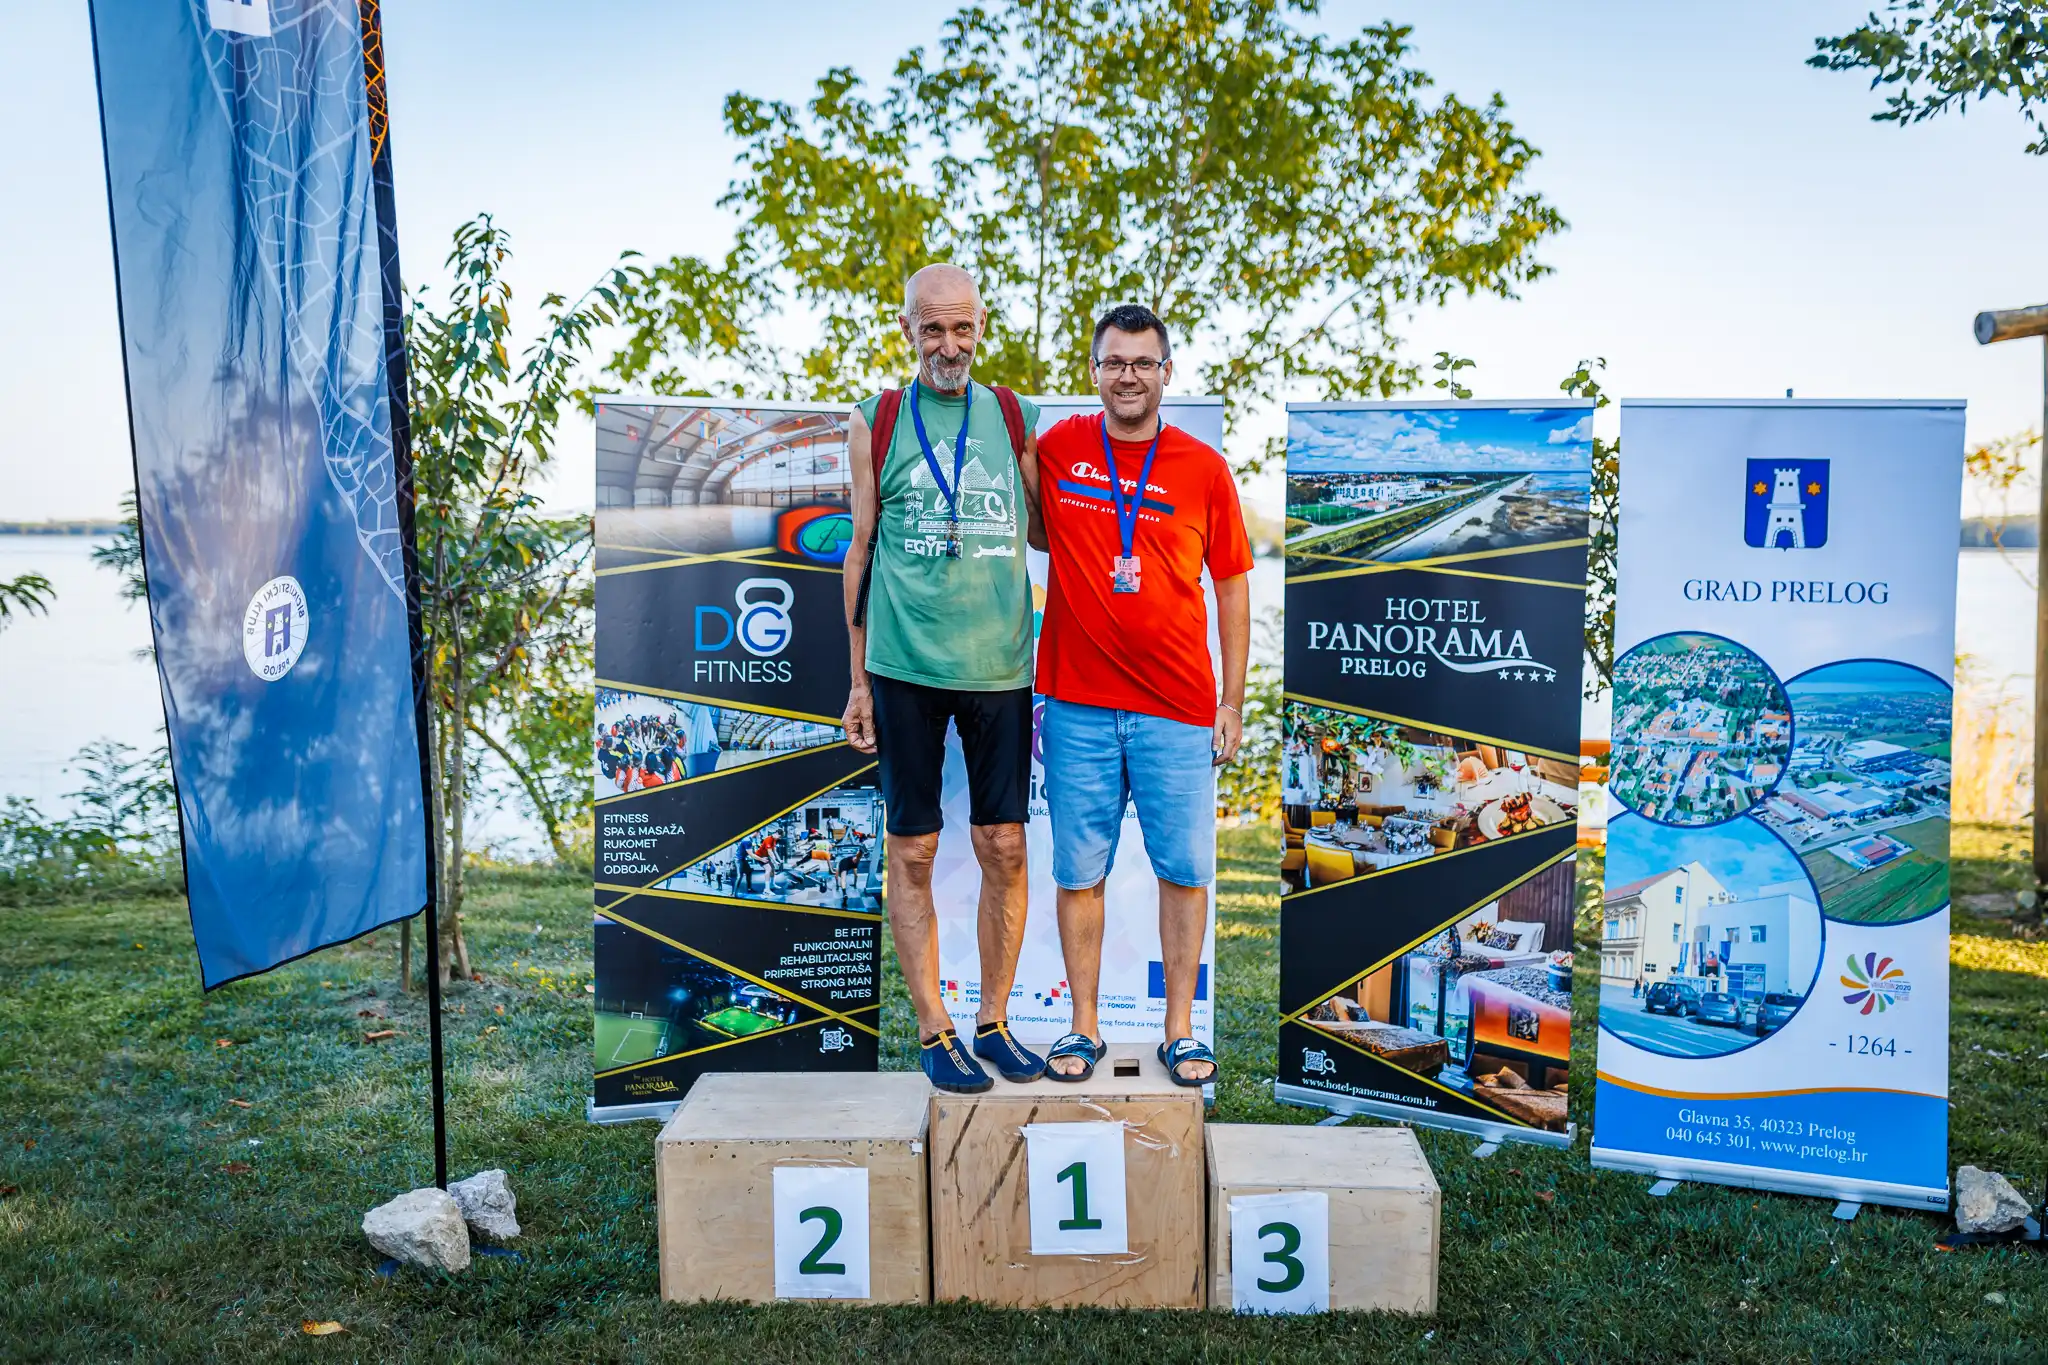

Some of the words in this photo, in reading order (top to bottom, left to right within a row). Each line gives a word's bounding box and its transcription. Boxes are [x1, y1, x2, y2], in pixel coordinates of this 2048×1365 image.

[1059, 498, 1098, 511] AUTHENTIC
[1139, 514, 1160, 522] WEAR
[1684, 579, 1762, 602] GRAD
[1771, 580, 1889, 605] PRELOG
[1385, 597, 1486, 624] HOTEL
[1307, 621, 1534, 661] PANORAMA
[694, 660, 792, 683] FITNESS
[1340, 656, 1427, 679] PRELOG
[603, 813, 649, 824] FITNESS
[603, 826, 626, 837] SPA
[628, 826, 636, 836] &
[638, 823, 686, 836] MASAŽA
[603, 838, 658, 849] RUKOMET
[603, 852, 646, 862] FUTSAL
[603, 864, 660, 875] ODBOJKA
[835, 928, 849, 938] BE
[851, 927, 873, 937] FITT
[793, 940, 873, 953] FUNKCIONALNI
[780, 952, 873, 966] REHABILITACIJSKI
[764, 967, 815, 979] PRIPREME
[817, 963, 873, 977] SPORTAŠA
[801, 979, 845, 990] STRONG
[848, 977, 872, 987] MAN
[830, 989, 872, 1000] PILATES
[1015, 1014, 1048, 1023] Europska
[1049, 1016, 1067, 1024] unija
[1114, 1019, 1136, 1027] fonda
[1847, 1034, 1897, 1057] 1264
[624, 1081, 675, 1092] PANORAMA
[1301, 1077, 1438, 1107] www.hotel-panorama.com.hr
[1678, 1108, 1730, 1128] Glavna
[1733, 1115, 1755, 1131] 35,
[1759, 1118, 1803, 1136] 40323
[1808, 1123, 1856, 1144] Prelog
[1666, 1127, 1692, 1142] 040
[1696, 1130, 1722, 1146] 645
[1726, 1133, 1757, 1151] 301,
[1761, 1140, 1868, 1164] www.prelog.hr
[1056, 1161, 1103, 1232] 1
[799, 1206, 846, 1276] 2
[1257, 1222, 1306, 1293] 3
